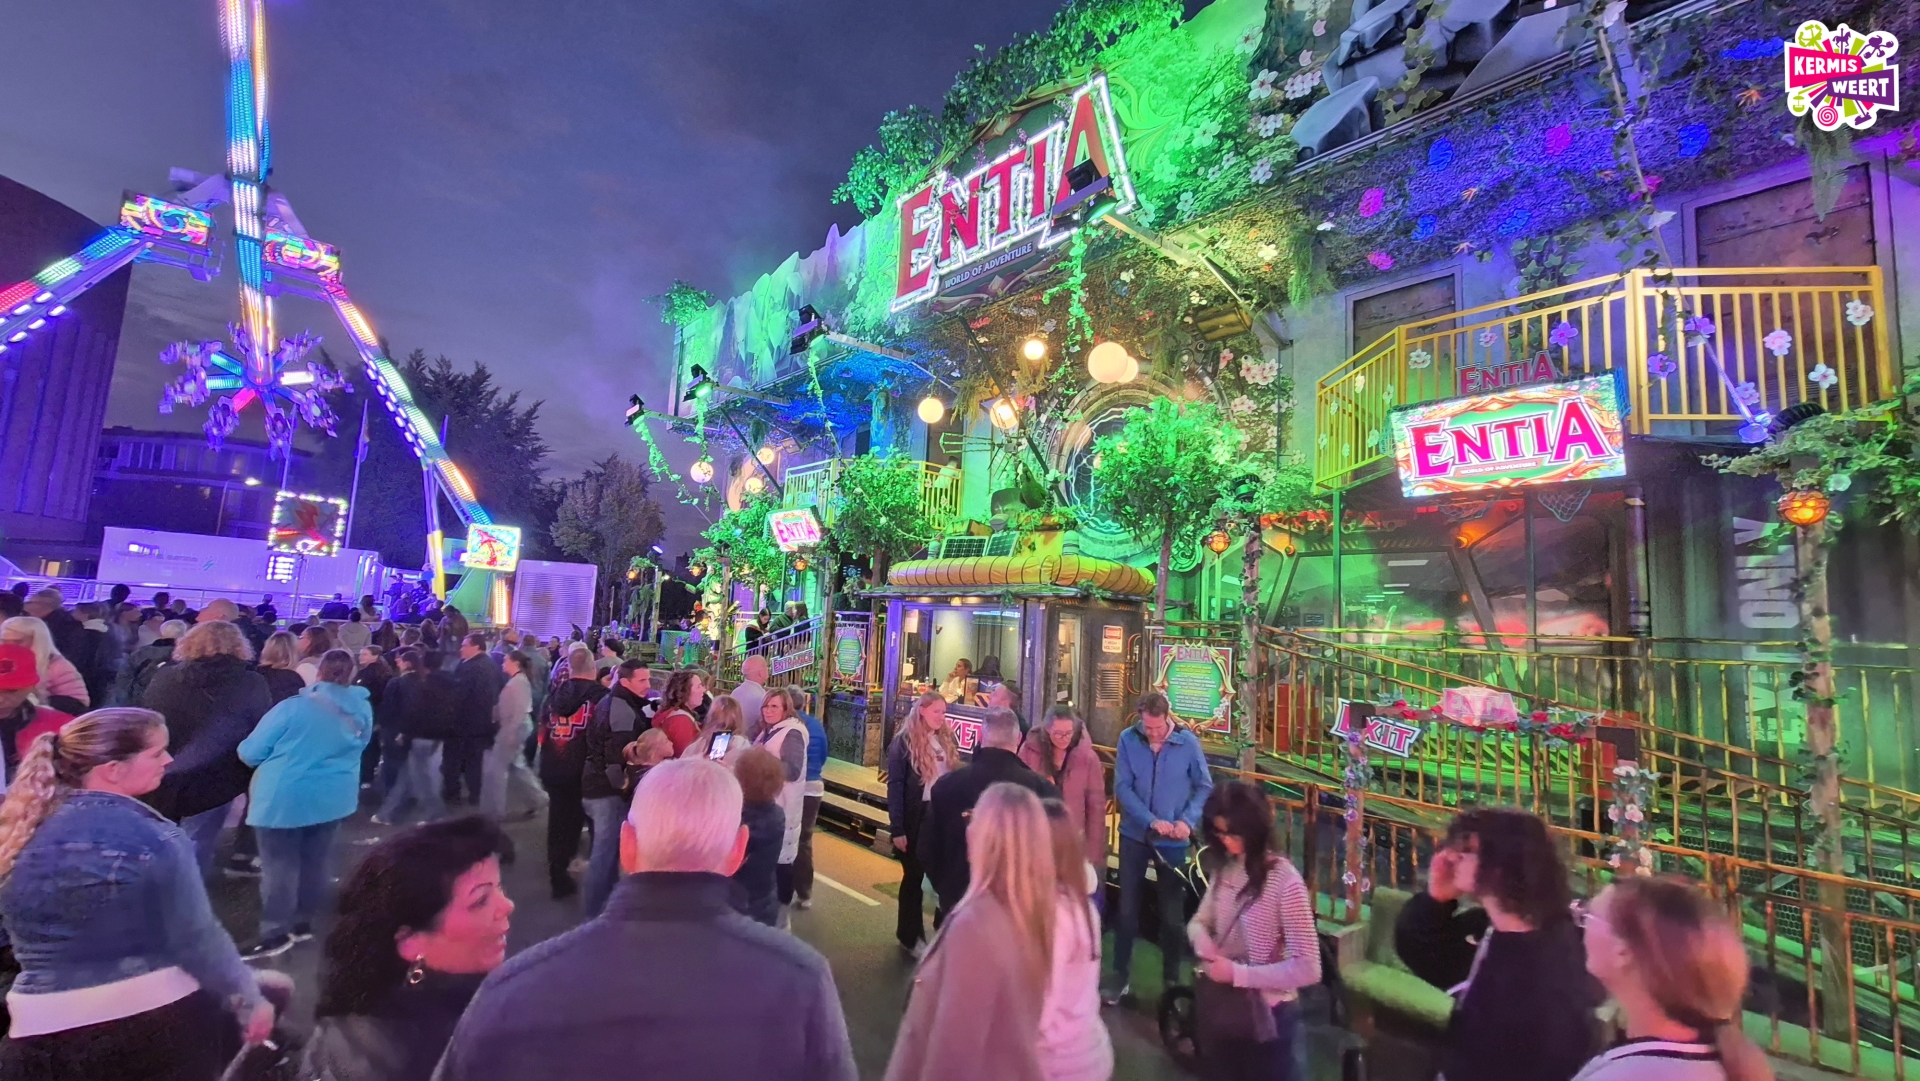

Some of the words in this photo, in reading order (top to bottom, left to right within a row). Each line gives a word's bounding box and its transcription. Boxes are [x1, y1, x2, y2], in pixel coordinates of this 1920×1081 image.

[892, 78, 1132, 310] ENTIA
[944, 271, 970, 289] WORLD
[971, 264, 983, 277] OF
[983, 242, 1033, 271] ADVENTURE
[1457, 350, 1557, 395] ENTIA
[1406, 395, 1621, 480] ENTIA
[774, 516, 819, 543] ENTIA
[1732, 516, 1799, 629] ONLY
[773, 650, 813, 674] ENTRANCE
[1175, 646, 1214, 663] ENTIA
